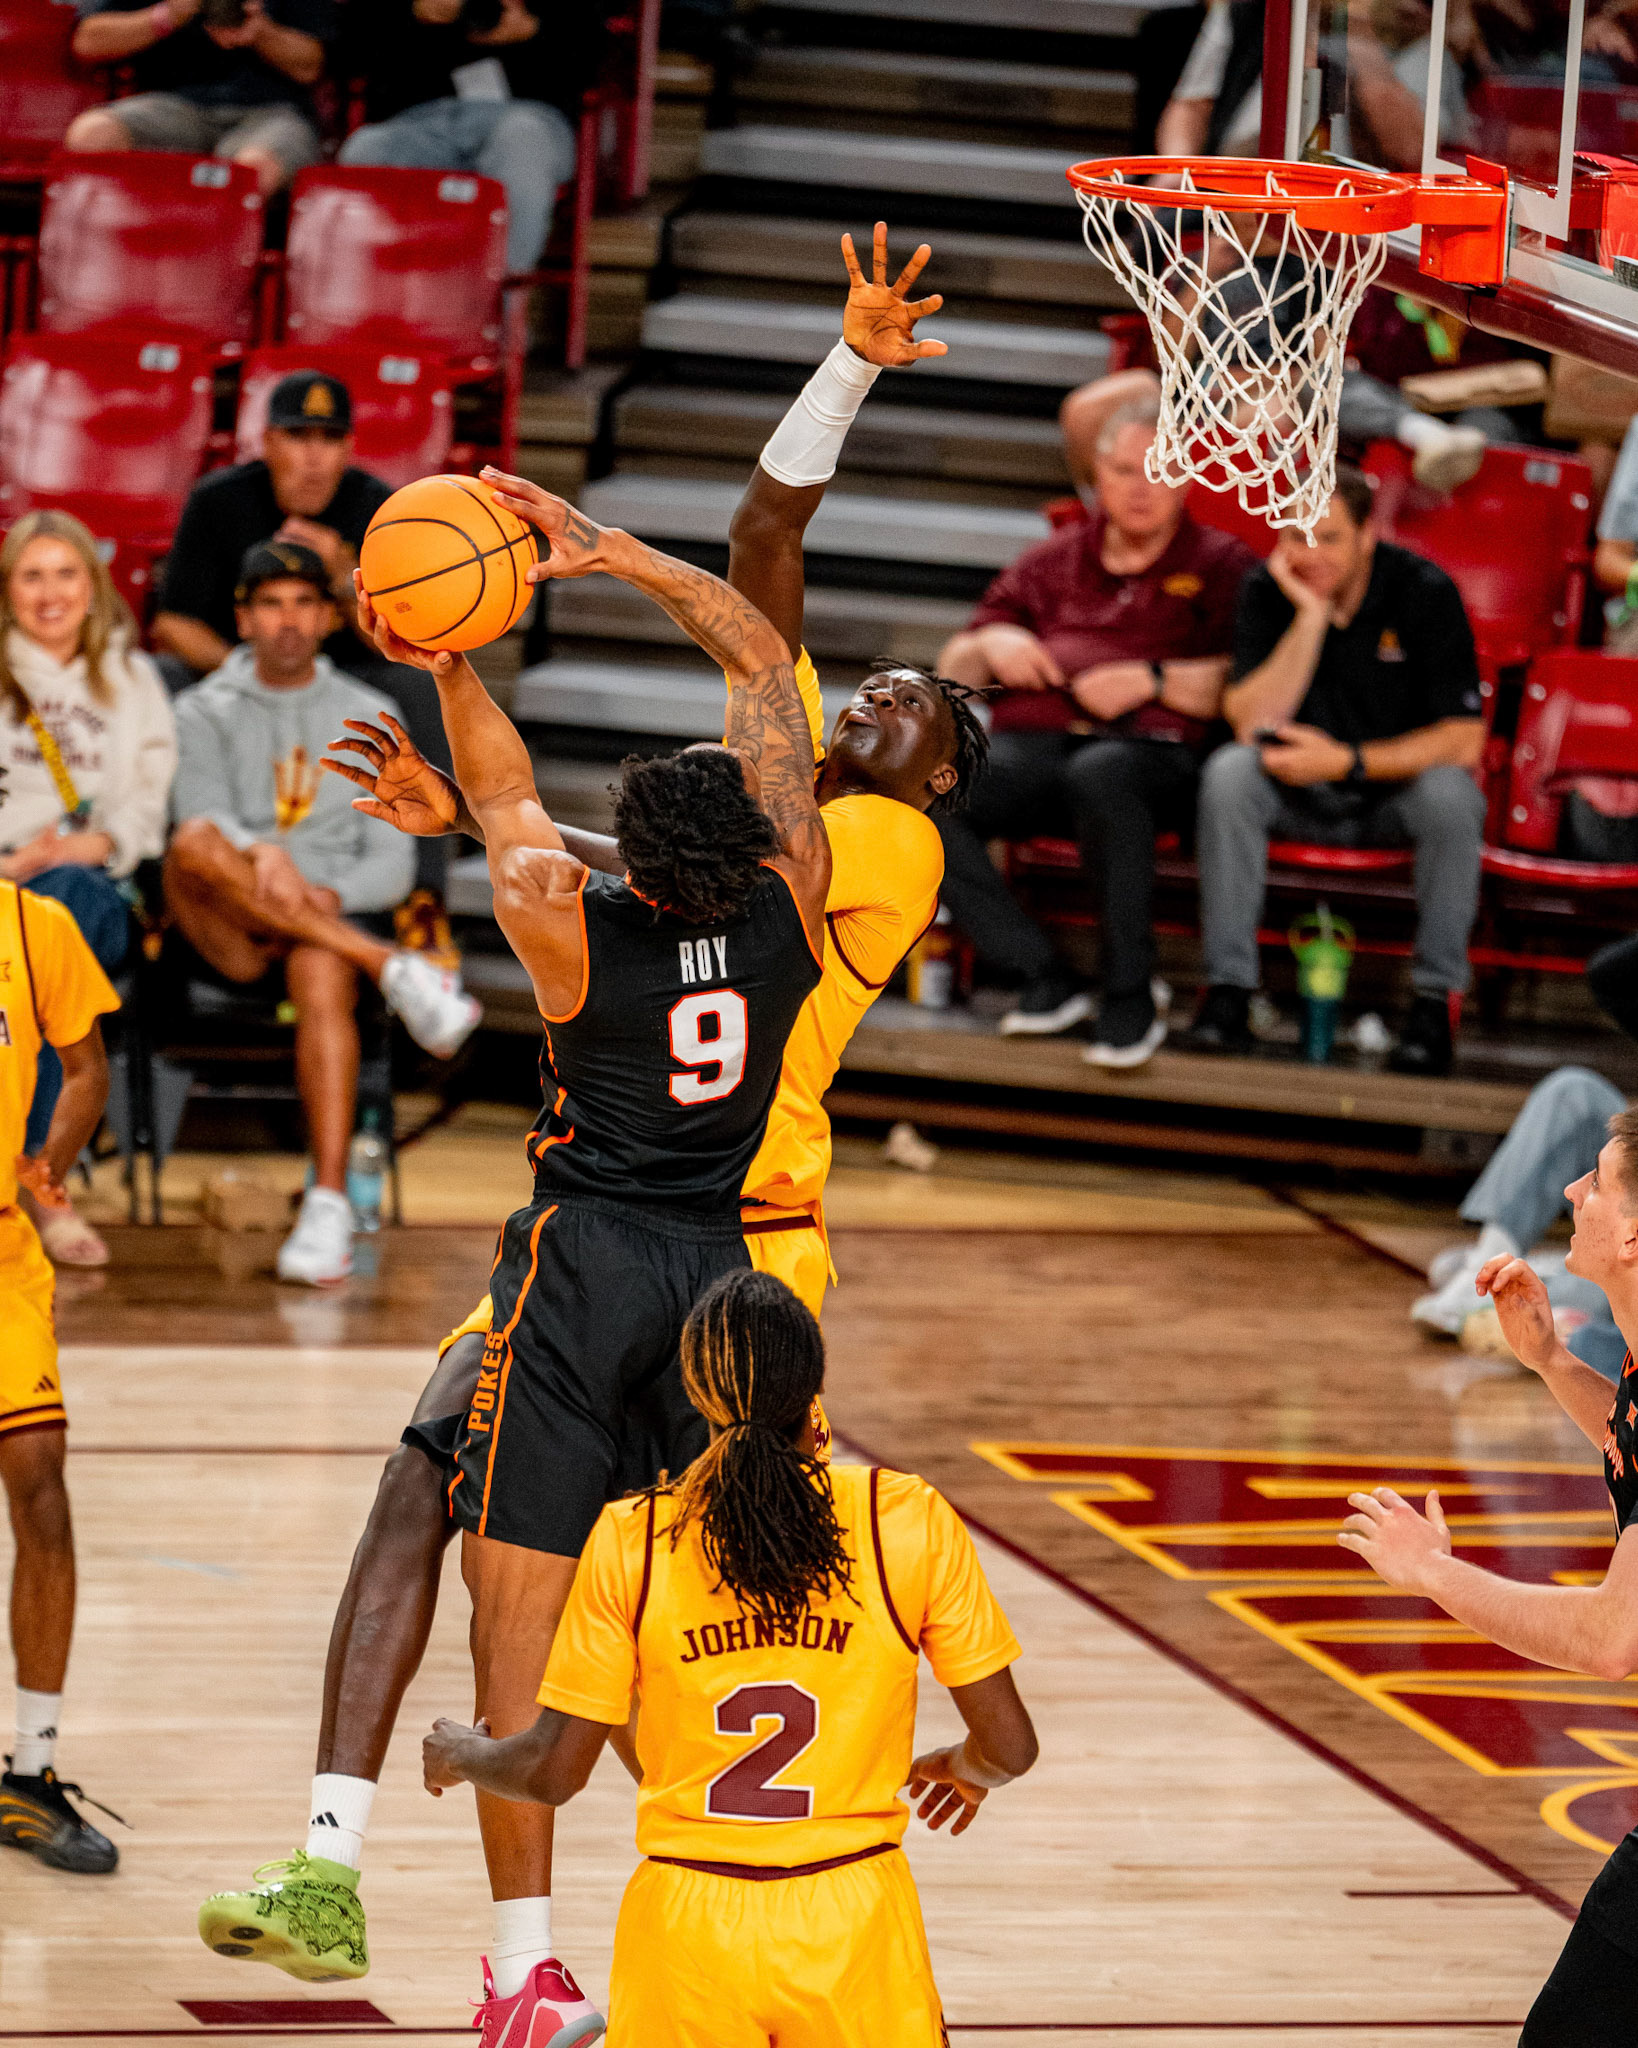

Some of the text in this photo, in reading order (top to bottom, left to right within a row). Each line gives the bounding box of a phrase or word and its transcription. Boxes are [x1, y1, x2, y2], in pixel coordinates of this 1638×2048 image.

[678, 935, 728, 984] ROY
[667, 988, 749, 1107] 9
[467, 1330, 505, 1433] POKES
[680, 1613, 854, 1664] JOHNSON
[704, 1680, 820, 1822] 2
